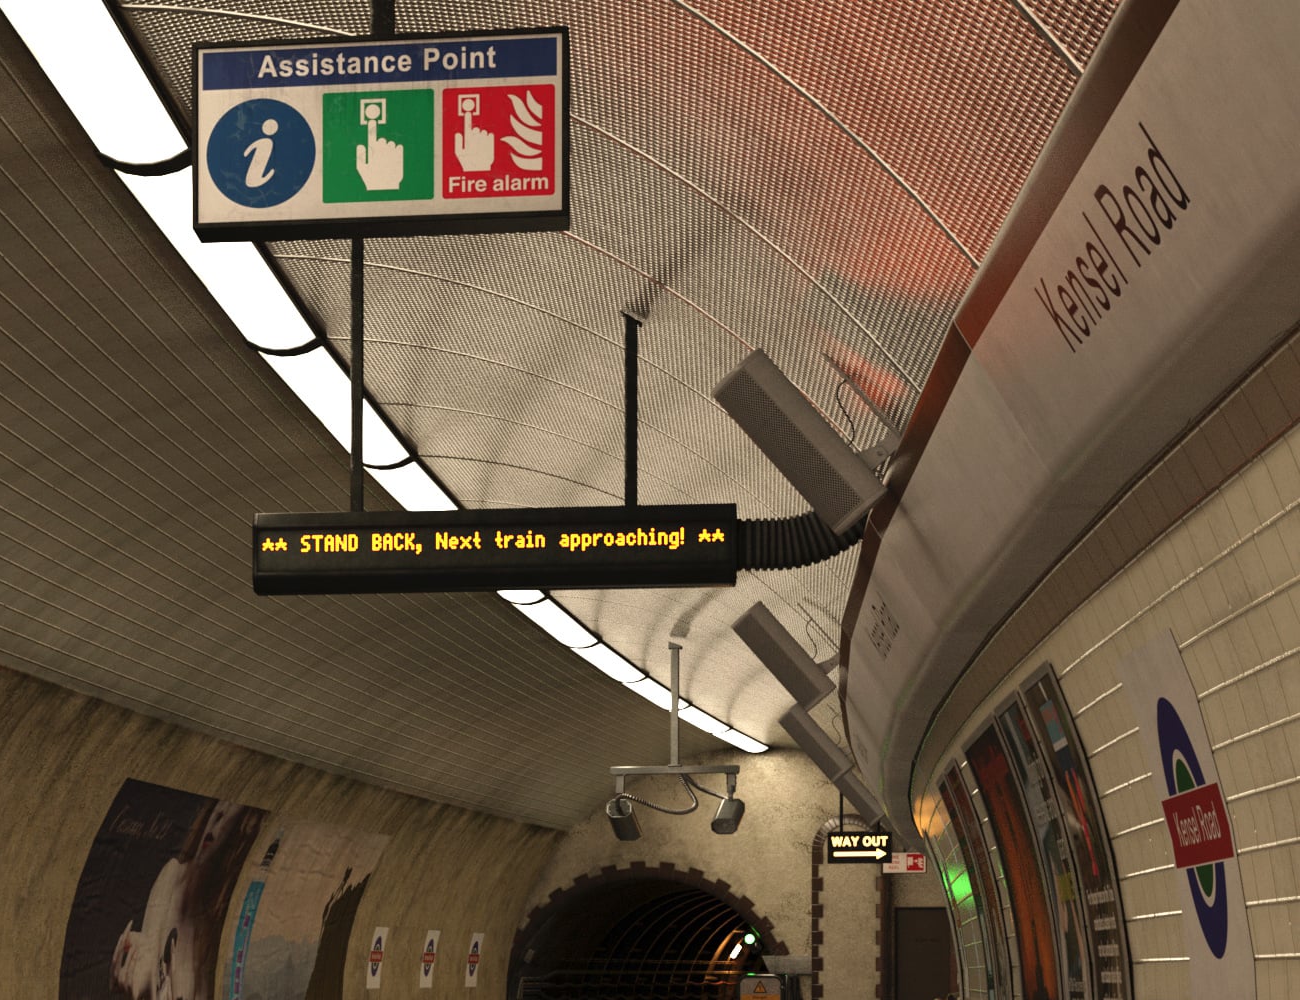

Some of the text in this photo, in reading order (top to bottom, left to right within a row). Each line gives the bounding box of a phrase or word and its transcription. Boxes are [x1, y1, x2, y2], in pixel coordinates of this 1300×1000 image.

[257, 45, 497, 79] Assistance Point
[447, 174, 549, 193] Fire alarm
[1034, 121, 1191, 354] Kensel Road
[300, 526, 686, 556] STAND BACK, Next train approaching!
[1173, 800, 1221, 847] Kensel Road
[830, 835, 888, 848] WAY OUT
